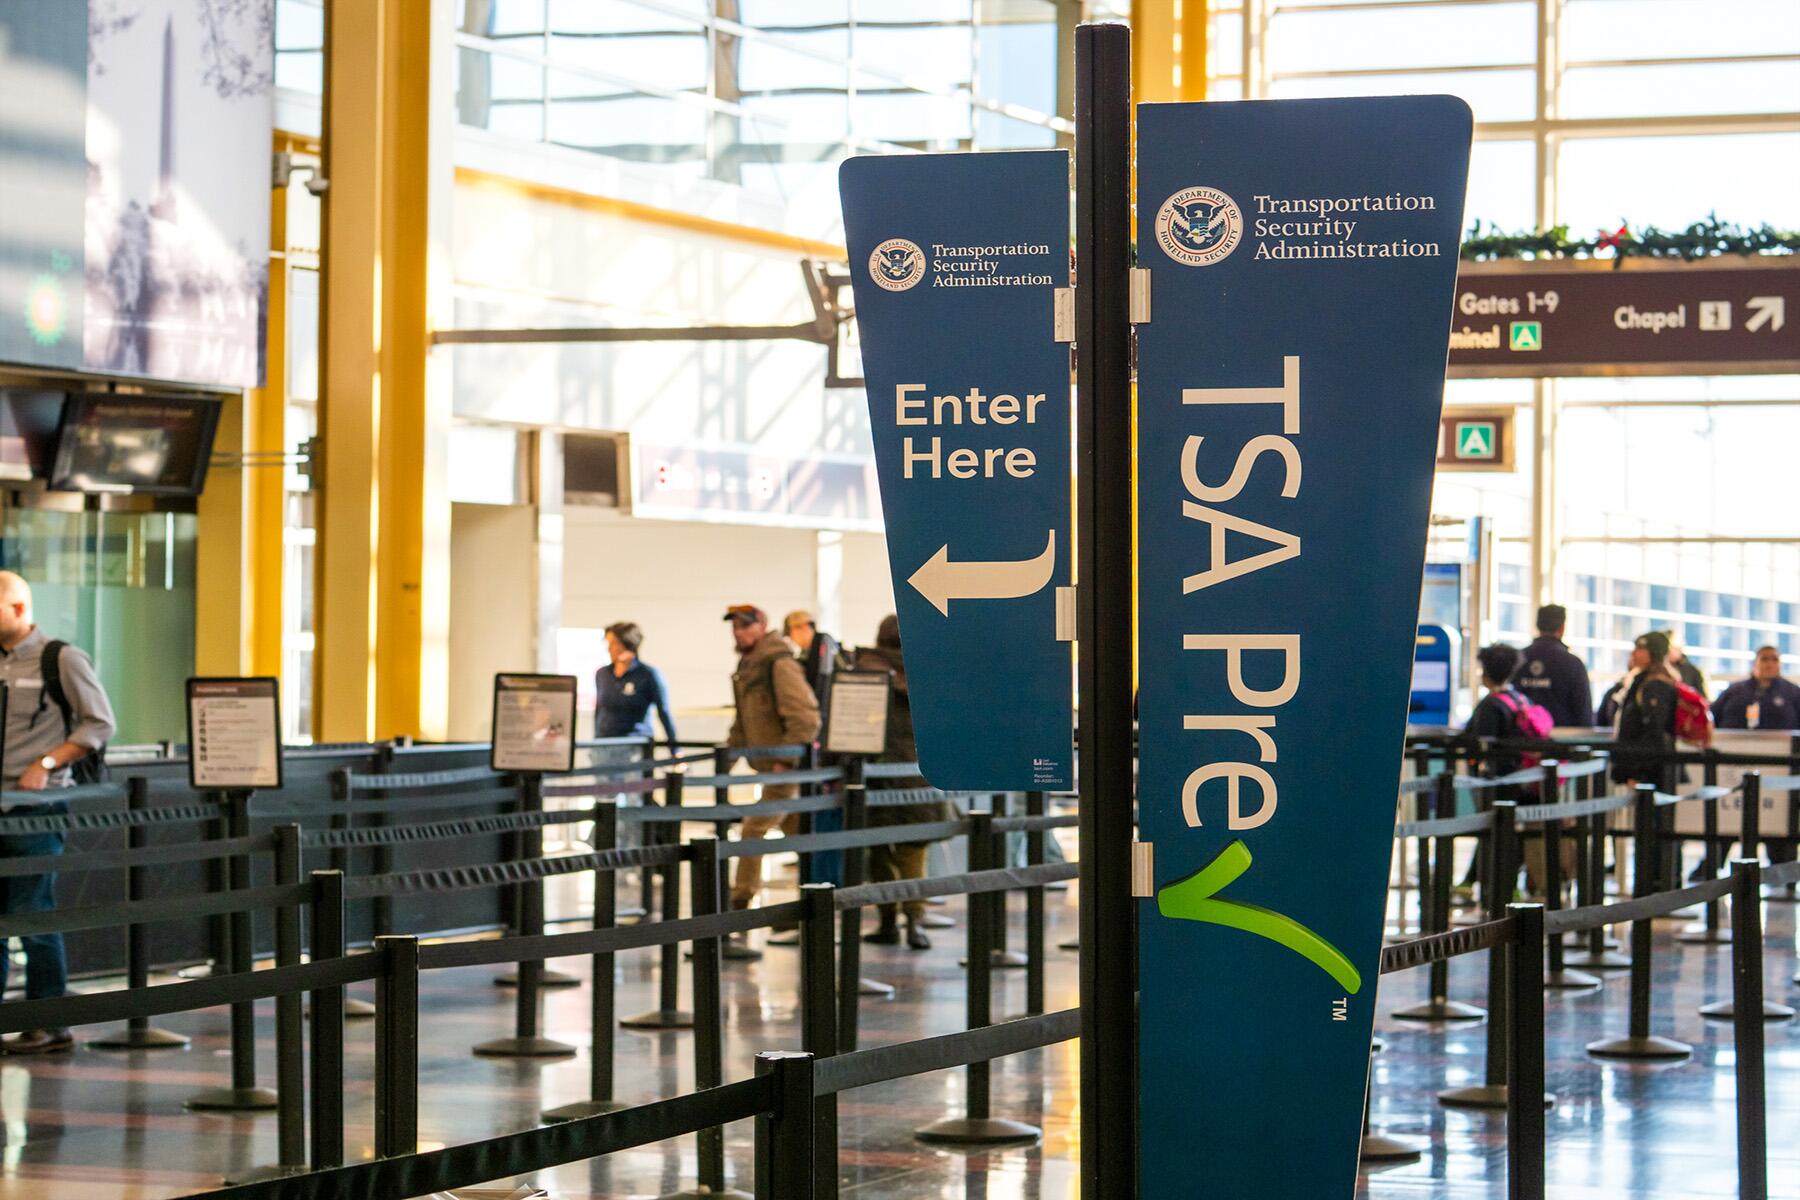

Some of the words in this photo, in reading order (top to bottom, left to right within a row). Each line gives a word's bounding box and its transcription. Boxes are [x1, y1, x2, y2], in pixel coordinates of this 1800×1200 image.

[1173, 190, 1233, 210] DEPARTMENT
[1228, 209, 1239, 220] OF
[1253, 193, 1436, 218] Transportation
[1255, 218, 1357, 240] Security
[932, 242, 1050, 260] Transportation
[1160, 230, 1200, 262] HOMELAND
[1204, 229, 1238, 262] SECURITY
[1253, 239, 1441, 260] Administration
[932, 259, 999, 274] Security
[932, 273, 1053, 288] Administration
[1459, 292, 1520, 315] Gates
[1527, 290, 1559, 314] 1-9
[1614, 304, 1686, 334] Chapel
[1449, 324, 1500, 350] minal
[896, 383, 1046, 425] Enter
[903, 437, 1037, 479] Here
[1180, 355, 1302, 595] TSA
[1182, 634, 1301, 830] Pre
